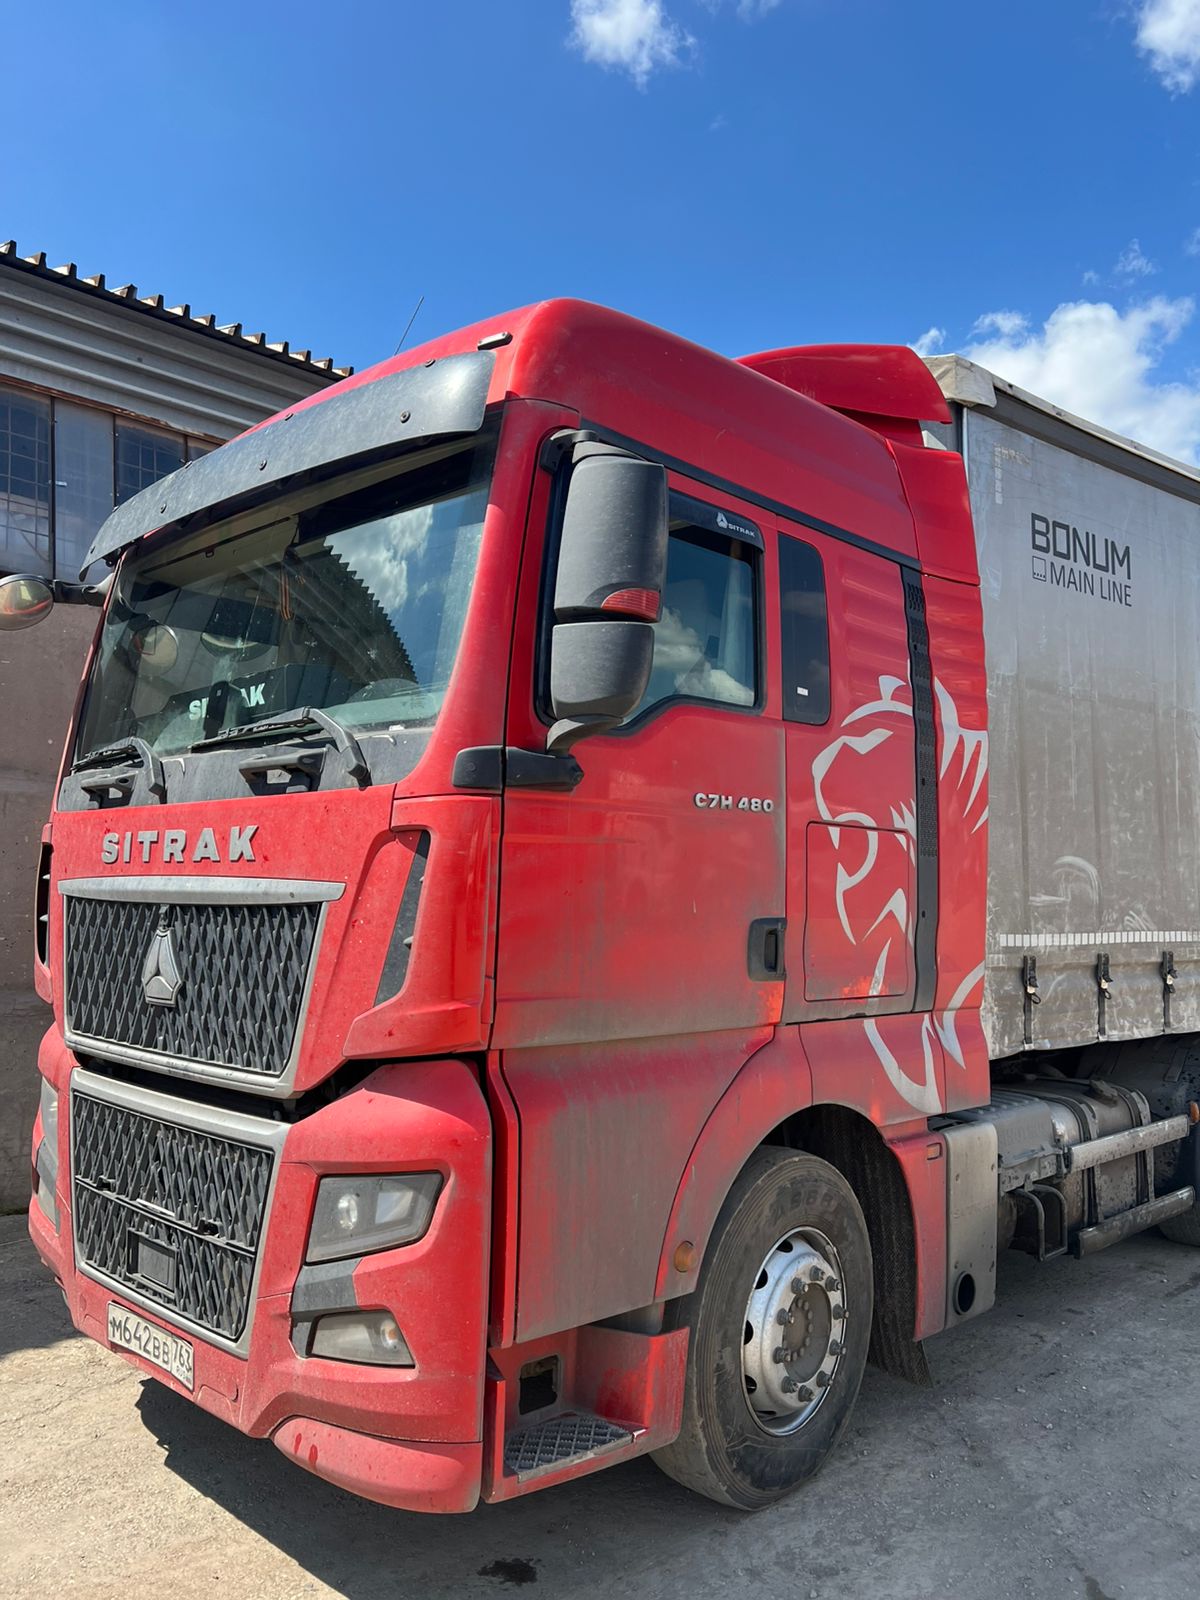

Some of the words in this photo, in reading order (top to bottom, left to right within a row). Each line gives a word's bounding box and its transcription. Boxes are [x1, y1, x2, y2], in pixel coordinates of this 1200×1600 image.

[1031, 512, 1131, 580] BONUM
[1050, 561, 1094, 596] MAIN
[1100, 577, 1132, 607] LINE
[694, 792, 733, 810] C7H
[737, 797, 774, 812] 480
[101, 824, 259, 864] SITRAK
